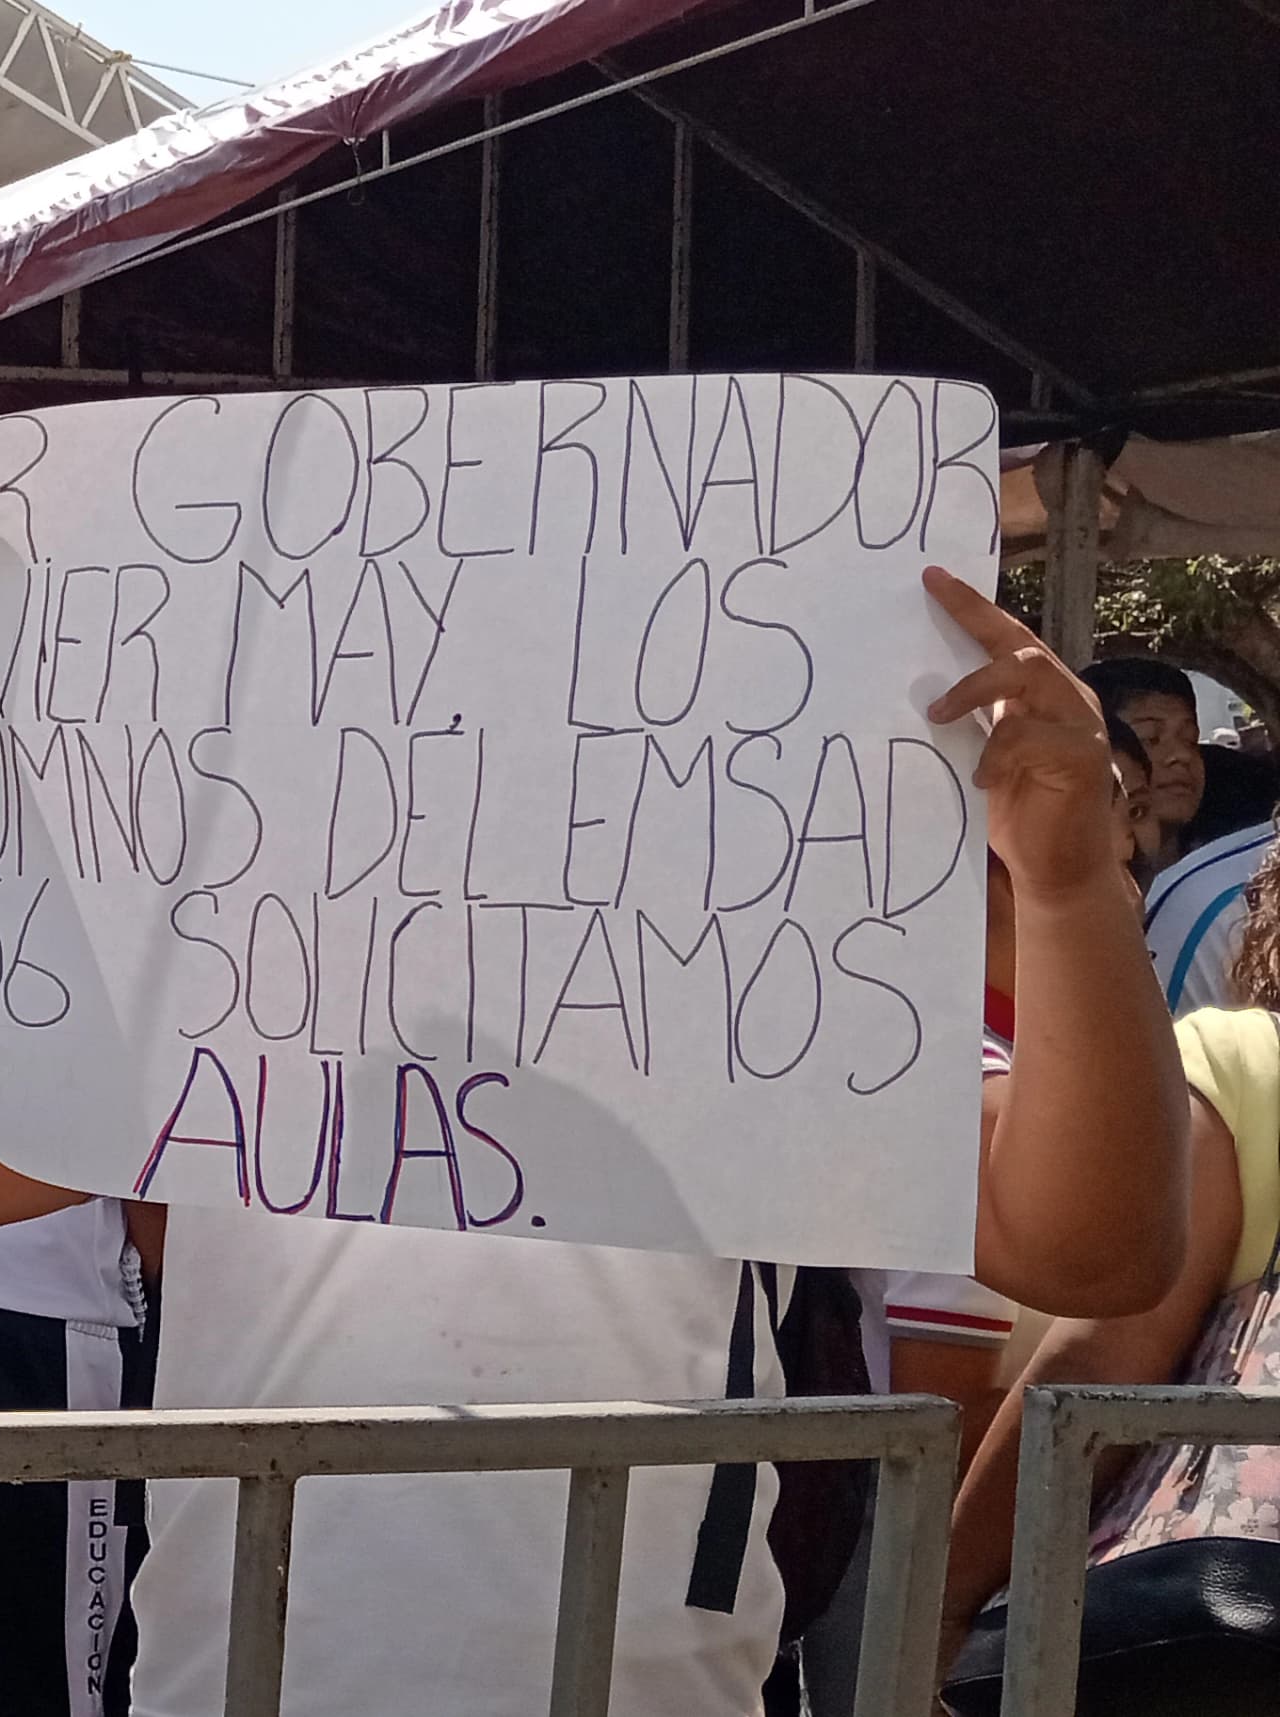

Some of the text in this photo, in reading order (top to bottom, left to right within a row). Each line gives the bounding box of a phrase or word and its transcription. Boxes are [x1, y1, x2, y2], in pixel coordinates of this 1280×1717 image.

[132, 373, 999, 564] GOBERNADOR
[567, 557, 814, 737] LOS
[323, 727, 488, 901] DEL
[562, 731, 968, 920] EMSAD
[171, 890, 923, 1096] SOLICITAMOS
[134, 1046, 548, 1231] AULAS.
[88, 1499, 109, 1695] EDUCACION
